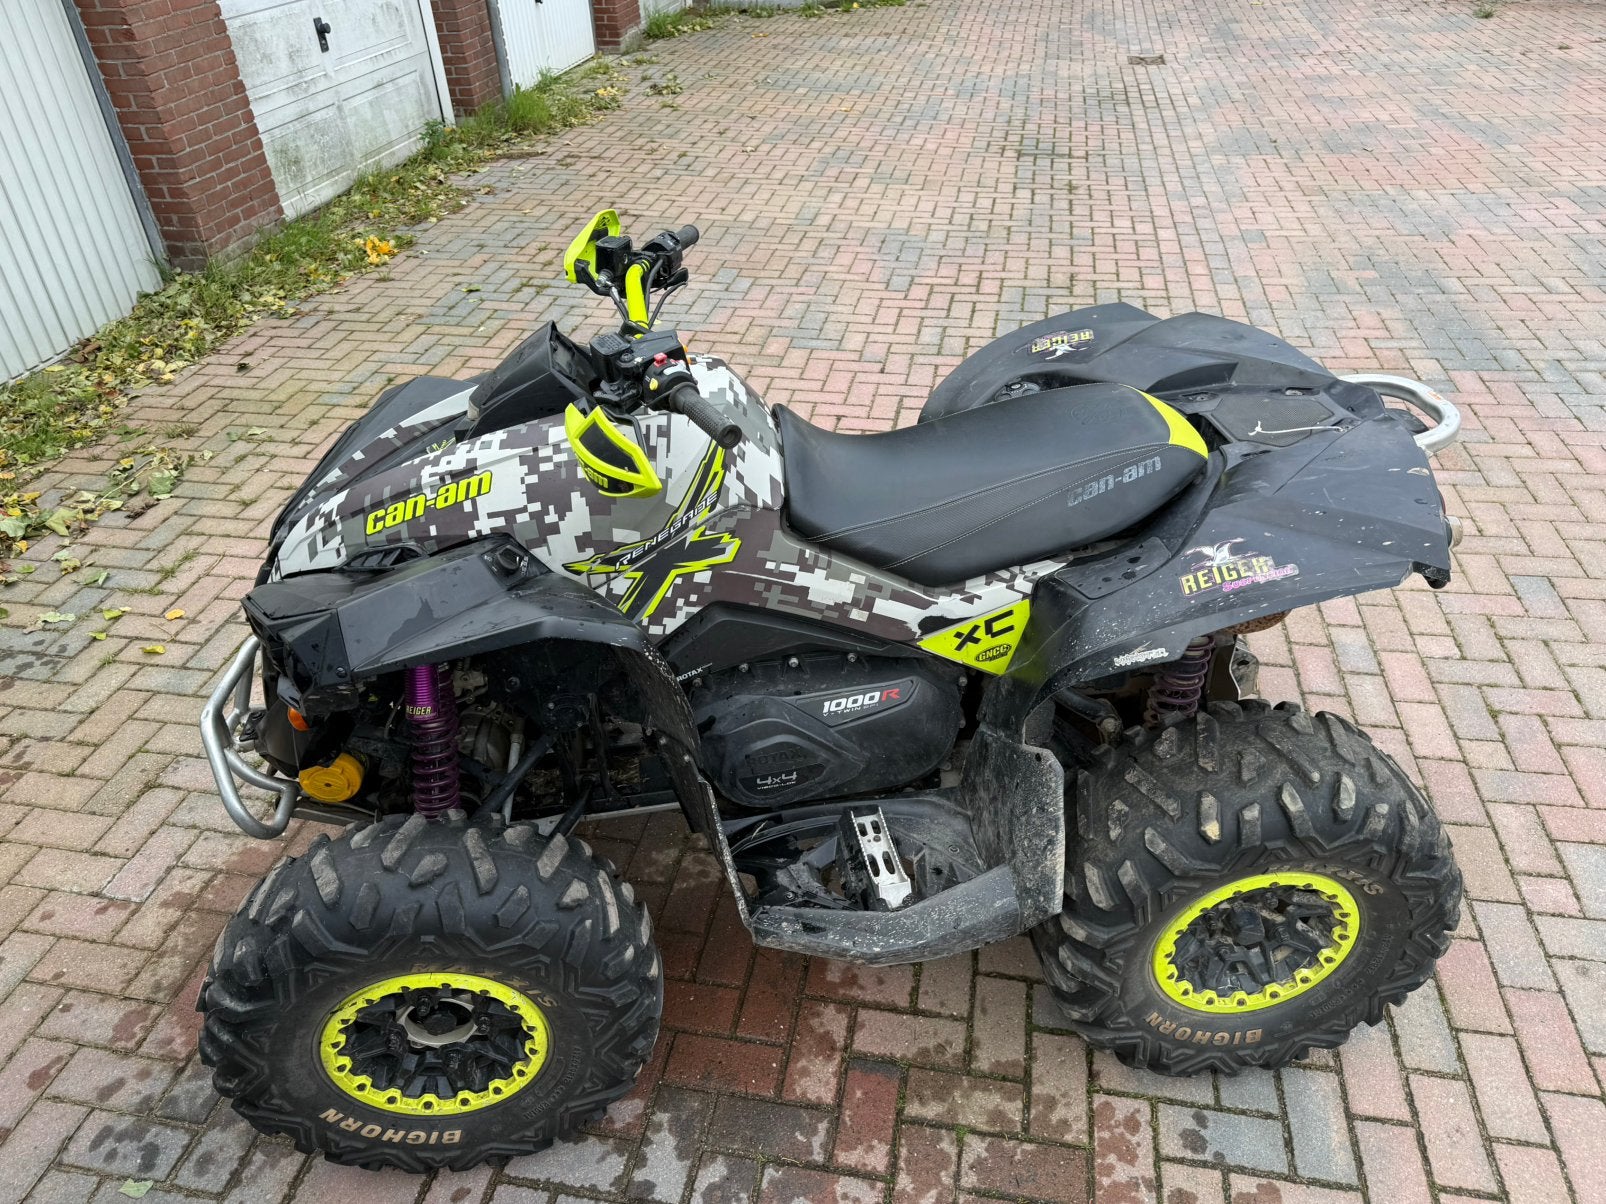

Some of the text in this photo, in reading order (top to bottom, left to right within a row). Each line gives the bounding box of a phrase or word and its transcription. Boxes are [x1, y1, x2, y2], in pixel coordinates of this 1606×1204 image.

[366, 470, 492, 535] can-am
[1067, 456, 1161, 507] can-am
[616, 491, 718, 570] RENEGADE
[953, 610, 1015, 652] XC
[822, 688, 900, 713] 1000R
[1145, 1012, 1263, 1046] BIGHORN
[318, 1108, 462, 1145] BIGHORN
